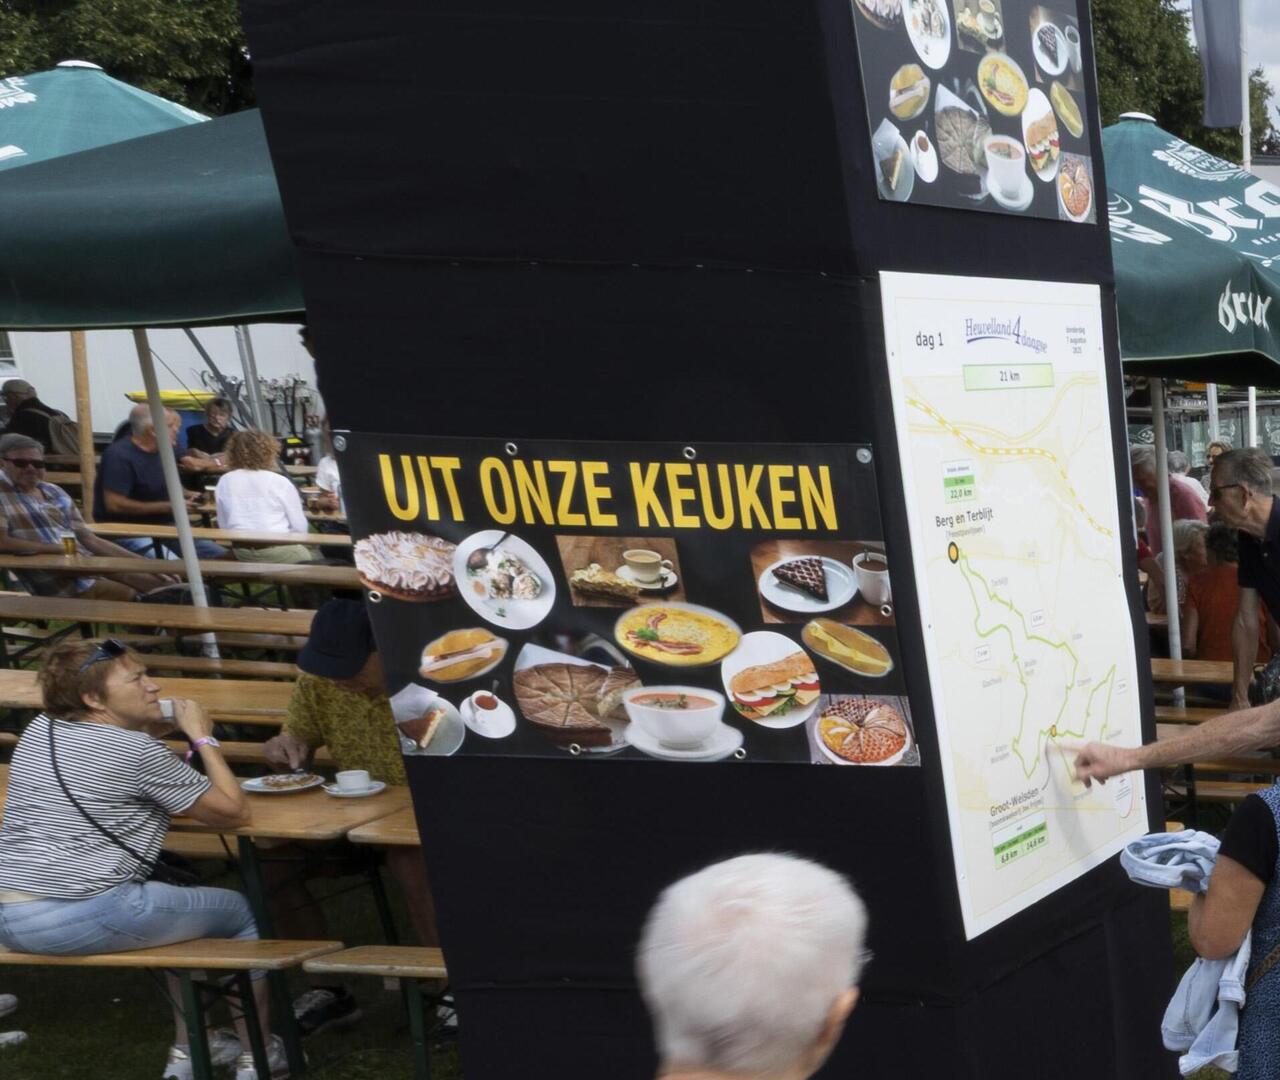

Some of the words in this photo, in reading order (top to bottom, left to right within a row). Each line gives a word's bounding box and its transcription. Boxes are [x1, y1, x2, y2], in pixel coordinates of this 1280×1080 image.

[916, 331, 935, 350] dag
[938, 332, 944, 347] 1
[1010, 370, 1020, 382] km
[378, 453, 465, 523] UIT
[479, 457, 618, 527] ONZE
[629, 462, 839, 531] KEUKEN
[935, 515, 954, 528] Berg
[955, 514, 966, 524] en
[966, 507, 994, 522] Terblijt
